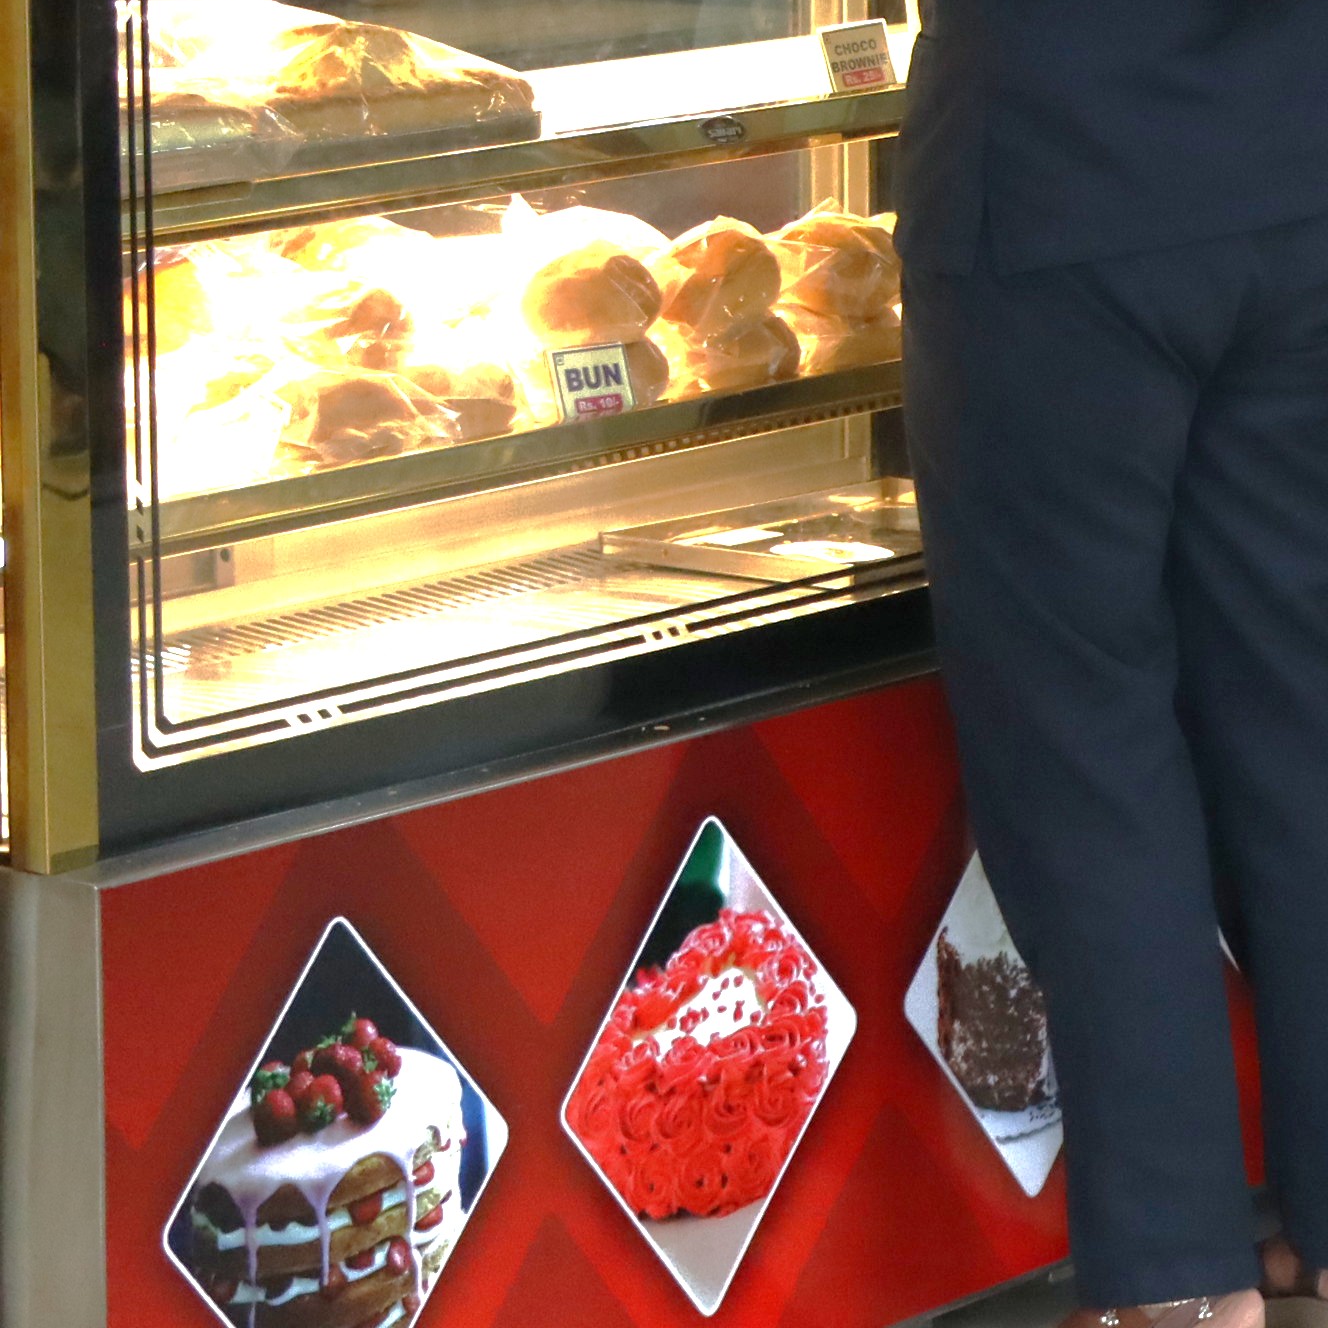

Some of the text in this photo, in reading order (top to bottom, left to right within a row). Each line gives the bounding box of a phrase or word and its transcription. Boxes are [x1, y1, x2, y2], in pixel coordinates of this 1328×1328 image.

[834, 38, 877, 56] CHOCO
[831, 52, 888, 73] BROWNIE
[564, 362, 624, 392] BUN
[578, 399, 597, 411] Rs.
